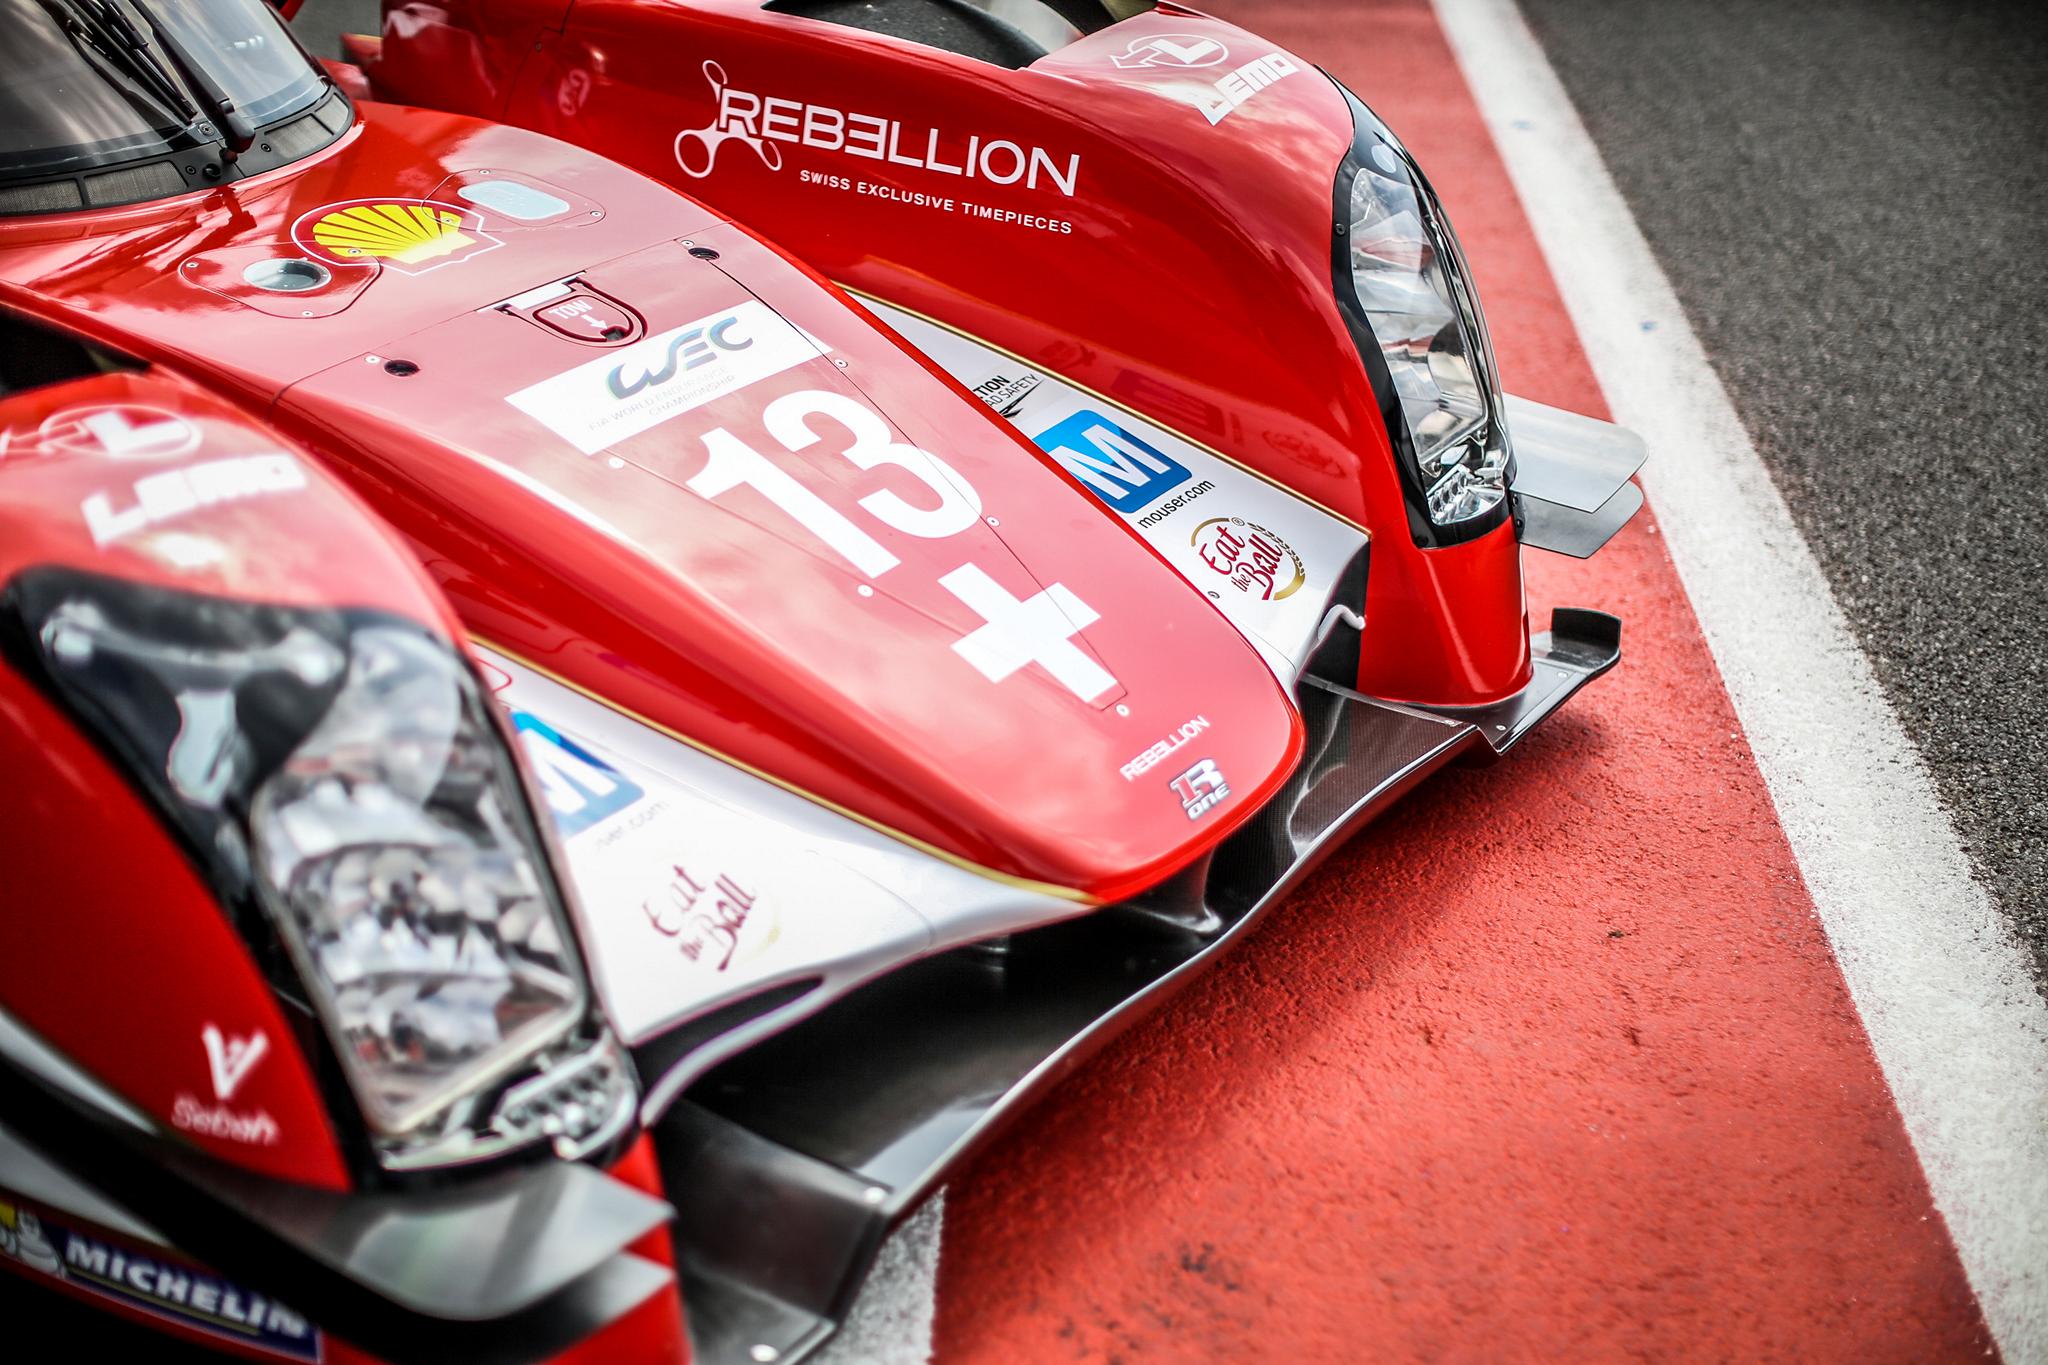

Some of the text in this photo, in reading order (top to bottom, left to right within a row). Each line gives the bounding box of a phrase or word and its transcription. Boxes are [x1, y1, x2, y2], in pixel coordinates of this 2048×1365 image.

[1195, 53, 1300, 127] LEMO
[718, 88, 1080, 197] REBELLION
[800, 169, 1073, 235] SWISS EXCLUSIVE TIMEPIECES
[549, 299, 594, 320] TOW
[605, 316, 754, 401] WEC
[973, 375, 1011, 399] TION
[998, 373, 1040, 399] SAFETY
[611, 396, 655, 421] WORLD
[649, 374, 736, 417] CHAMPIONSHIP
[685, 389, 983, 580] 13
[1137, 480, 1216, 529] mouser.com
[1199, 525, 1246, 576] Eat
[1231, 533, 1283, 601] the Ball
[1120, 715, 1210, 782] REBELLION
[65, 1231, 310, 1339] MICHELIN
